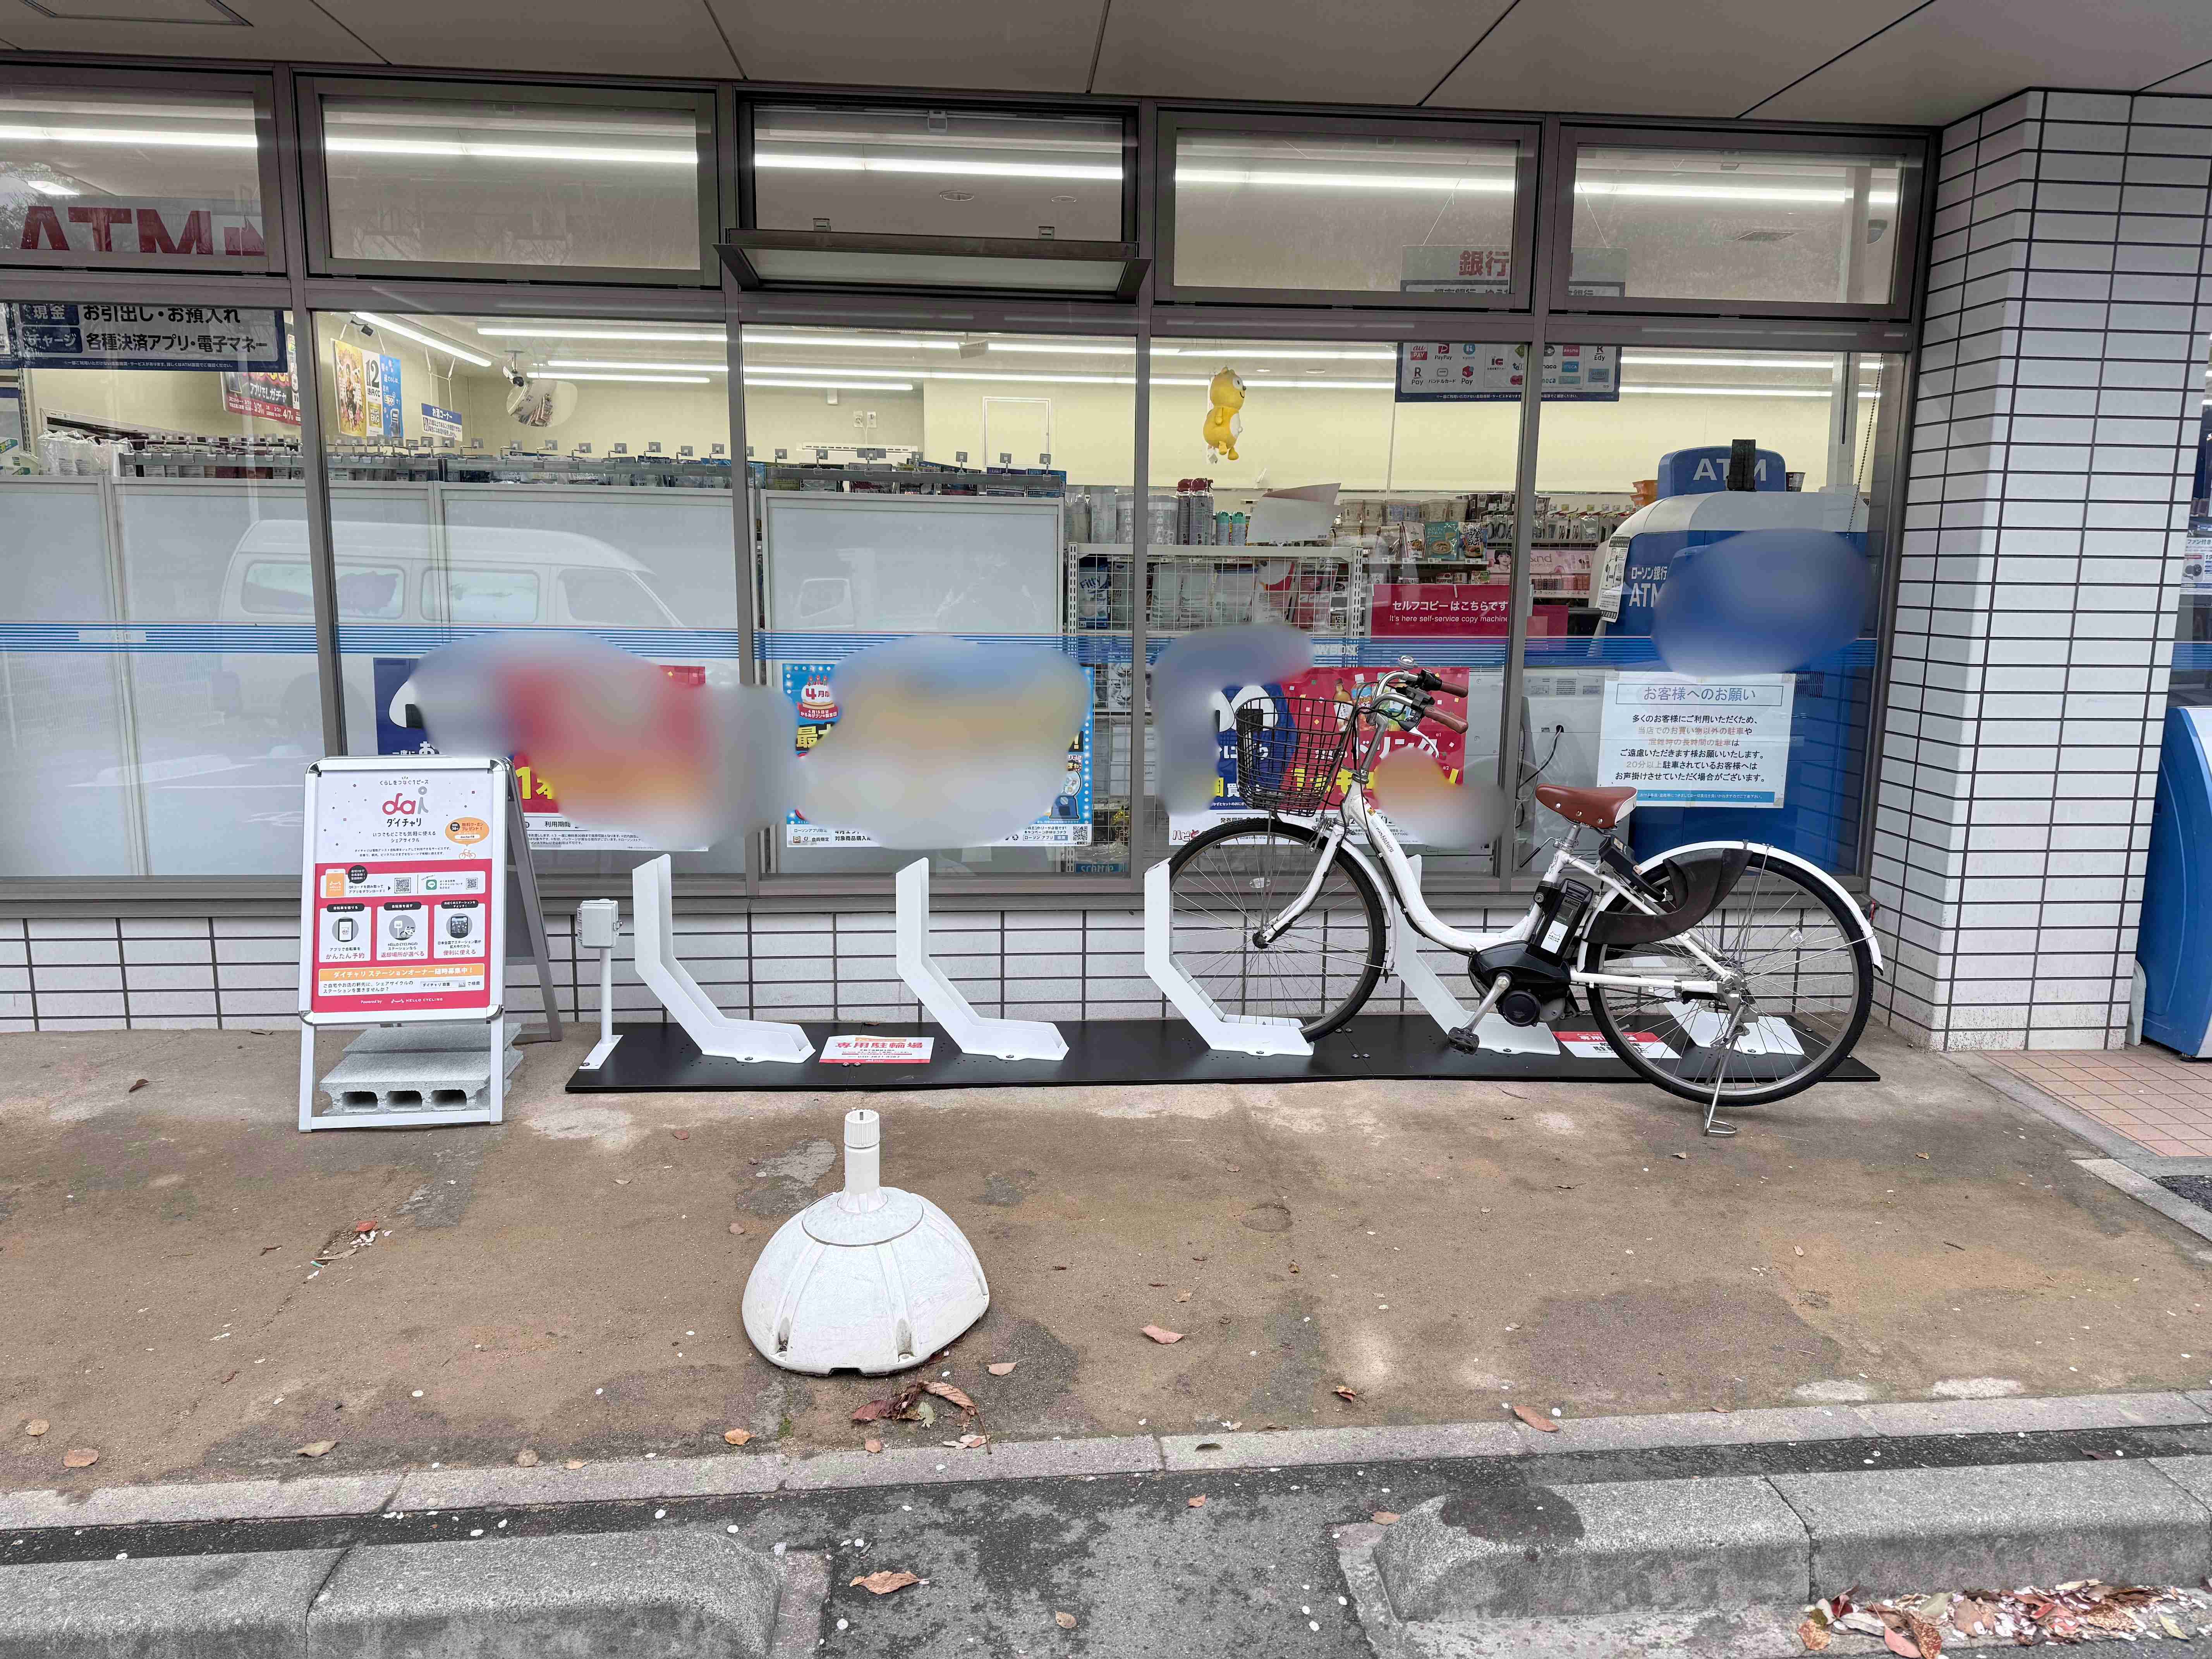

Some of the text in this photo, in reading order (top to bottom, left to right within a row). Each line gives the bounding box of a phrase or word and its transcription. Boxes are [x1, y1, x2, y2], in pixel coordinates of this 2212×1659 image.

[21, 206, 213, 255] ATM
[1459, 250, 1510, 276] 銀行
[27, 333, 76, 347] チャージ
[86, 333, 268, 352] 各種決済アプリ・電子マネー
[366, 359, 380, 388] 12
[371, 414, 380, 422] BIG
[1631, 566, 1668, 580] ローソン銀行
[1393, 601, 1508, 611] セルフコピーはこちらです
[1643, 686, 1756, 701] お客様へのお願い
[1632, 714, 1758, 725] 多くのお客様にご利用いただくため、
[1638, 726, 1753, 735] 当店でのお買い物以外の駐車や
[1620, 749, 1764, 760] ご遠慮いただきます様お願いいたします。
[1626, 761, 1757, 770] 20分以上駐車されているお客様へは
[1615, 772, 1765, 783] お声掛けさせていただく場合がございます。
[382, 787, 429, 815] dai
[387, 818, 421, 827] ダイチャリ
